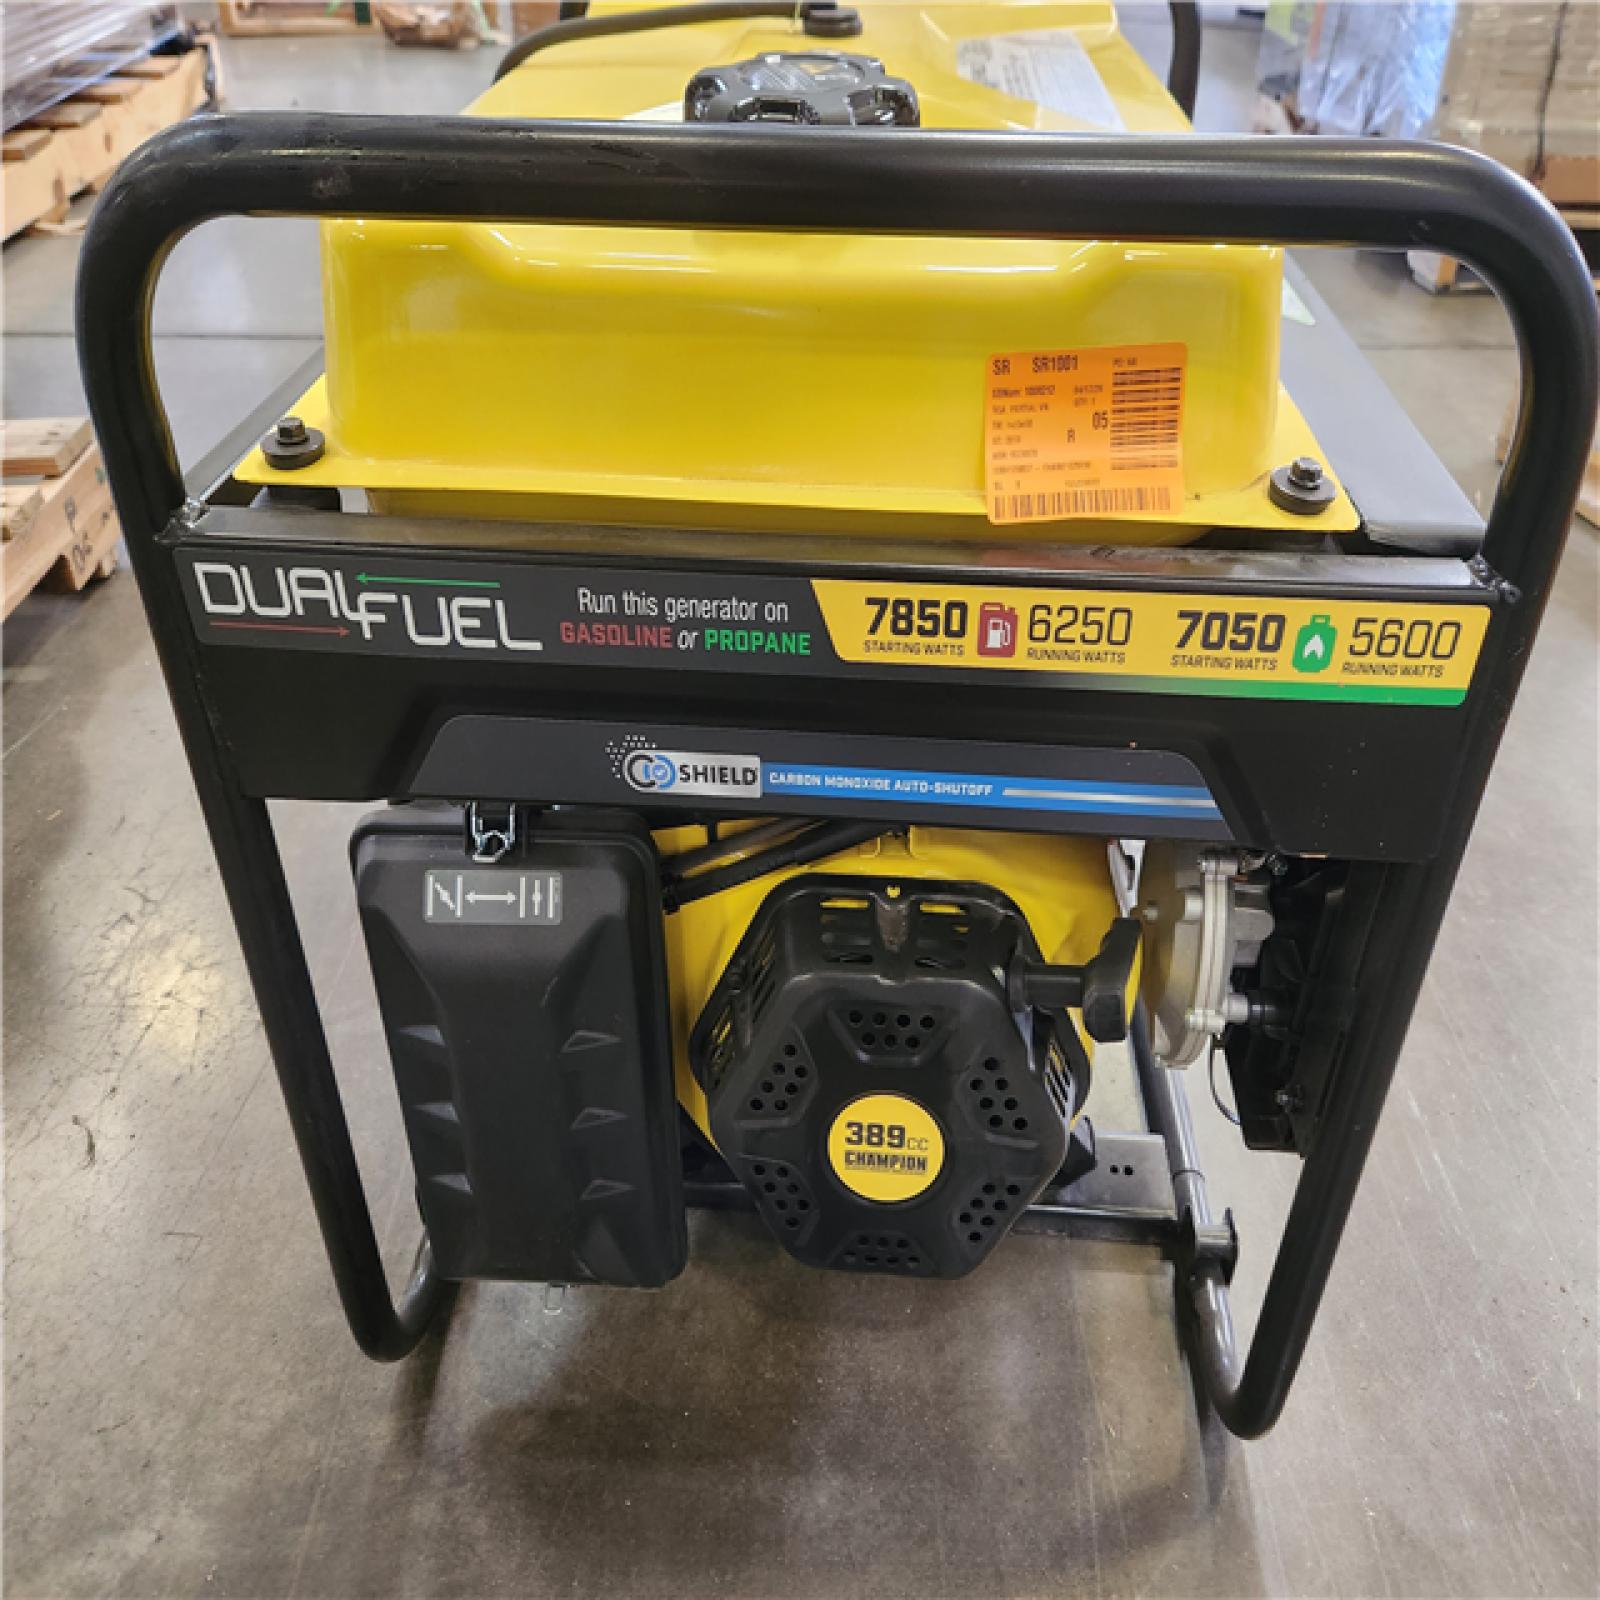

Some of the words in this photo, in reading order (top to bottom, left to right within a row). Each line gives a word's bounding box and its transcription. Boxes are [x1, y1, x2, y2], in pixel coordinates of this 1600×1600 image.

[992, 359, 1011, 376] SR
[1032, 354, 1078, 373] SR1001
[1092, 411, 1109, 431] 05
[577, 586, 617, 614] Run
[622, 590, 659, 616] this
[664, 596, 759, 624] generator
[764, 601, 789, 623] on
[865, 597, 968, 638] 7850
[1028, 604, 1133, 646] 6250
[560, 621, 673, 649] GASOLINE
[677, 629, 700, 651] or
[704, 627, 811, 656] PROPANE
[1175, 609, 1286, 653] 7050
[1349, 616, 1462, 660] 5600
[864, 639, 921, 656] STARTING
[924, 643, 965, 658] WATTS
[1027, 647, 1081, 663] RUNNING
[1083, 650, 1127, 665] WATTS
[1171, 654, 1232, 670] STARTING
[1234, 657, 1279, 672] WATTS
[1341, 661, 1398, 677] RUNNING
[1400, 663, 1445, 679] WATTS
[679, 764, 758, 787] SHIELD
[769, 771, 821, 786] CARBON
[824, 774, 891, 791] MONOXIDE
[894, 779, 993, 797] AUTO-SHUTOFF
[845, 1151, 929, 1171] CHAMPION
